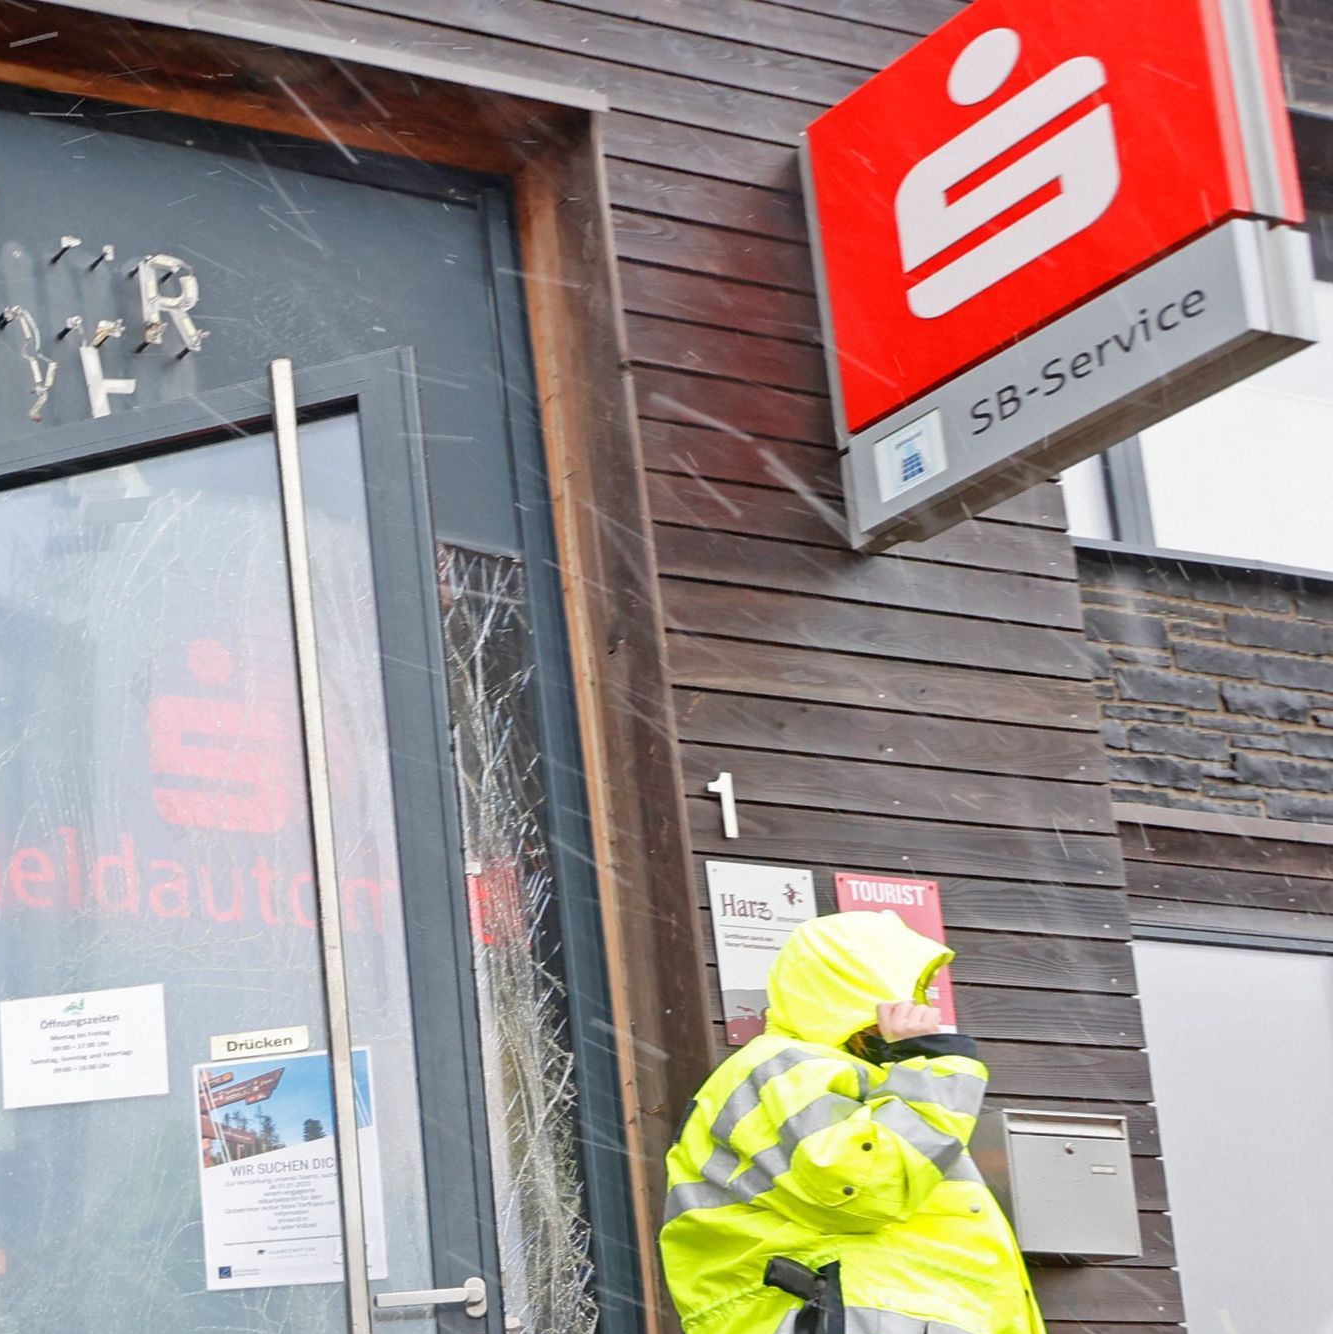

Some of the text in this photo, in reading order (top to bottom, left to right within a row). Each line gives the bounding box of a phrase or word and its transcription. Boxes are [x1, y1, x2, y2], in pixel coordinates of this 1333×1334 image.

[970, 287, 1206, 437] SB-Service
[707, 771, 739, 839] 1
[718, 892, 773, 921] Harz
[846, 879, 926, 907] TOURIST
[39, 1013, 120, 1031] Öffnungszeiten
[226, 1035, 293, 1052] Drücken
[230, 1157, 335, 1177] WIR SUCHEN DIC
